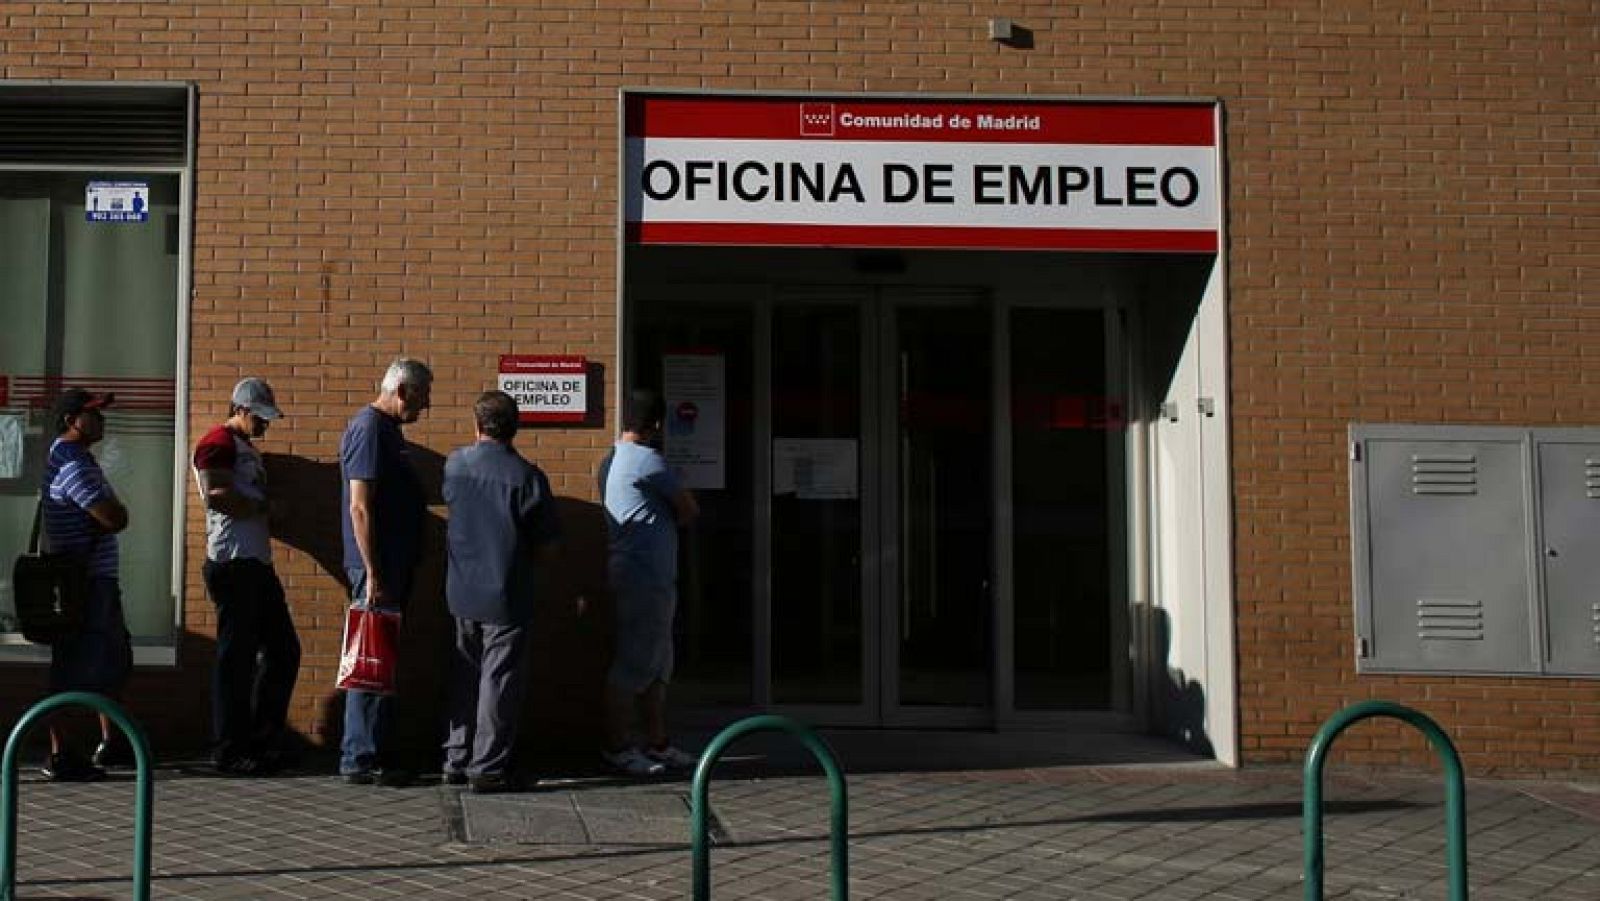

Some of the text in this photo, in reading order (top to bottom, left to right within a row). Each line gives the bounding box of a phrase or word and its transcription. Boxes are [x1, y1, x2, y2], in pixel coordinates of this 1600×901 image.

[839, 112, 1041, 131] Comunidad de Madrid
[642, 159, 1200, 208] OFICINA DE EMPLEO
[503, 380, 582, 393] OFICINA DE
[514, 393, 571, 406] EMPLEO
